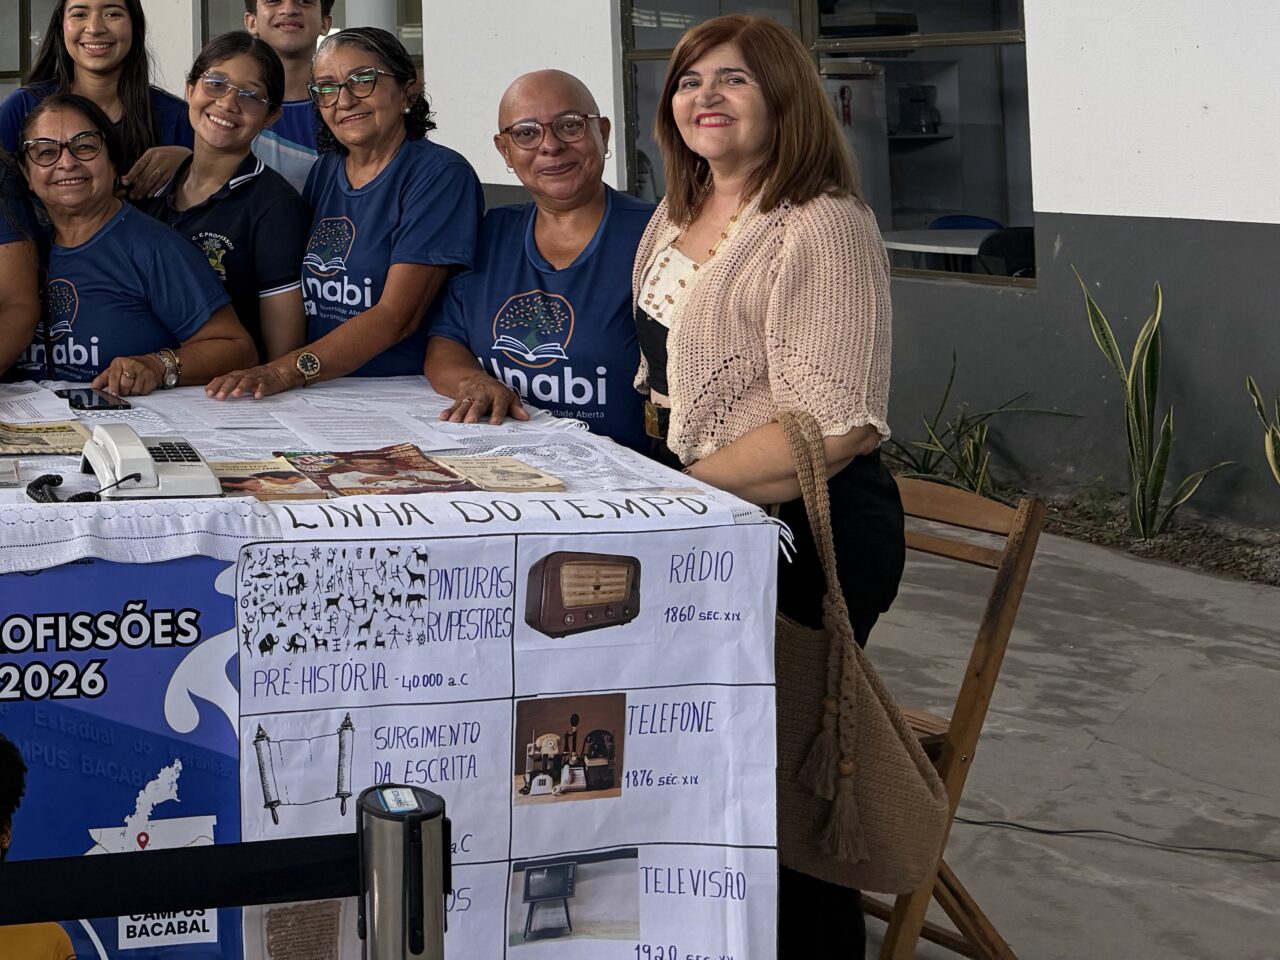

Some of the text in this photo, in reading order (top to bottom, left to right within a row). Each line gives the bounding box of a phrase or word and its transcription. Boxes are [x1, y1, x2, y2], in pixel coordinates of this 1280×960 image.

[302, 275, 372, 308] nabi
[576, 410, 605, 419] Aberta
[283, 496, 709, 528] LINHA DO TEMPO
[669, 546, 734, 584] RÁDIO
[428, 565, 514, 602] PINTURAS
[426, 606, 514, 643] RUPESTRES
[664, 604, 696, 623] 1860
[724, 611, 741, 622] XIX
[253, 658, 389, 697] PRÉ-HISTÓRIA
[33, 708, 115, 746] Estadual
[628, 701, 717, 736] TELEFONE
[374, 721, 481, 750] SURGIMENTO
[19, 740, 71, 770] MPUS
[374, 754, 478, 785] DA ESCRITA
[625, 769, 654, 789] 1876
[681, 775, 699, 786] XIX
[639, 866, 747, 901] TELEVISÃO
[126, 919, 210, 939] BACABAL
